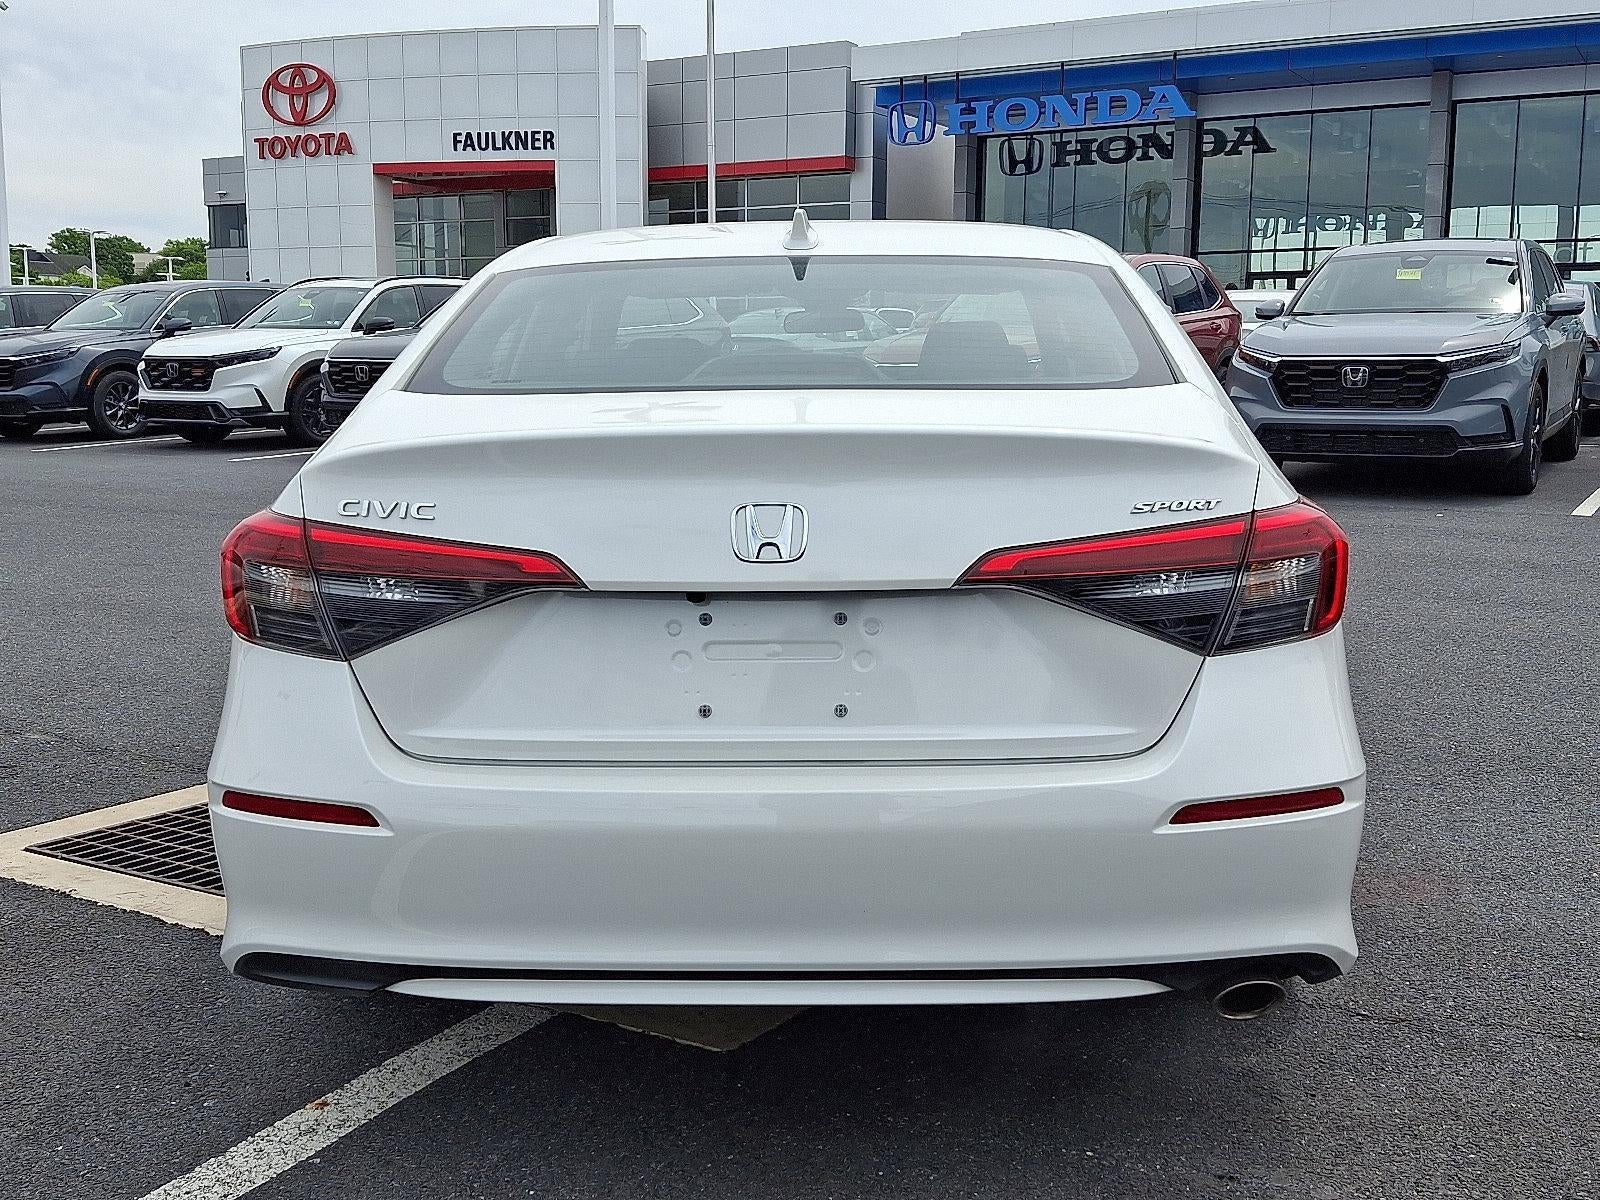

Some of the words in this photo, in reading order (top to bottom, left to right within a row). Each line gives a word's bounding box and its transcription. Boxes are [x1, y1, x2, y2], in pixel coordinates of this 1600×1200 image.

[943, 84, 1197, 136] HONDA
[253, 132, 356, 160] TOYOTA
[452, 130, 556, 152] FAULKNER
[338, 499, 436, 520] CIVIC
[1130, 499, 1222, 514] SPORT
